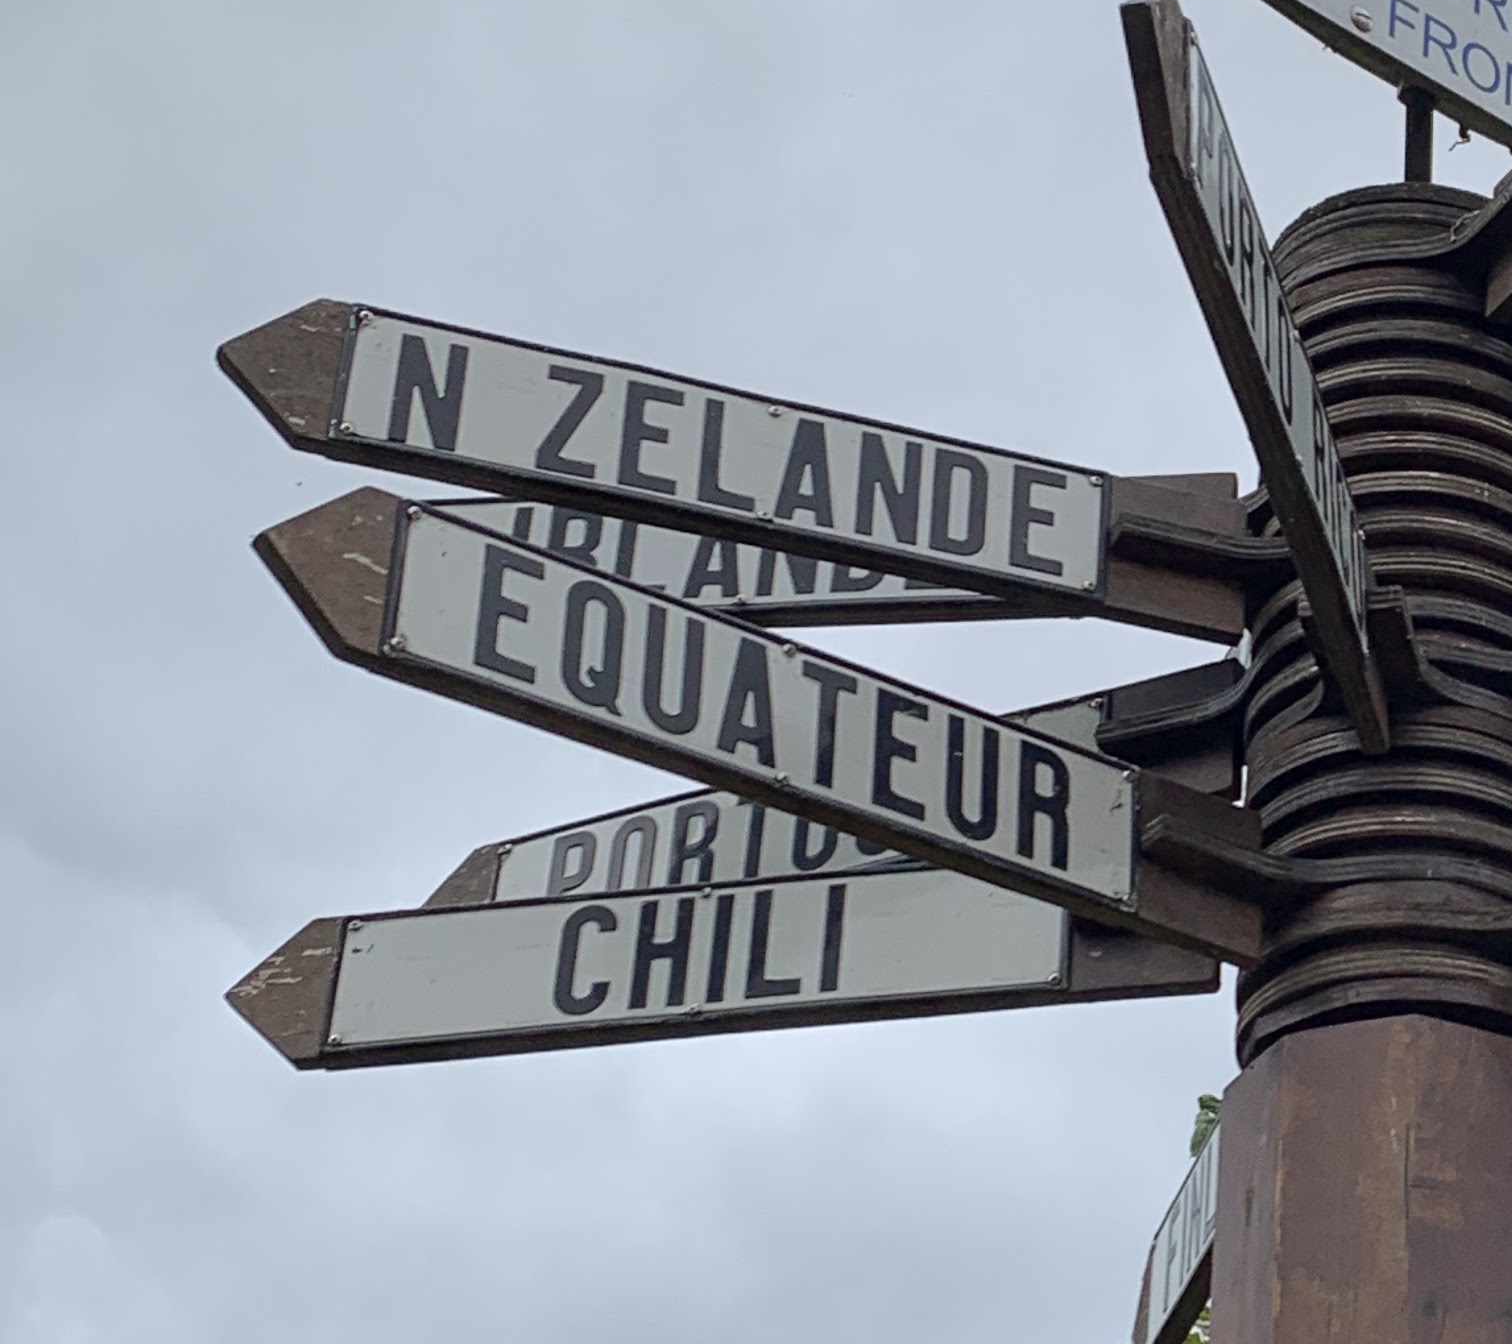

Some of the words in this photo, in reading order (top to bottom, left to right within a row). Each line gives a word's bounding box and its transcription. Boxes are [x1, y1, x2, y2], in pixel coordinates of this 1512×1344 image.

[387, 333, 469, 452] N
[535, 364, 1067, 577] ZELANDE
[473, 544, 1070, 871] EQUATEUR
[552, 882, 847, 1016] CHILI
